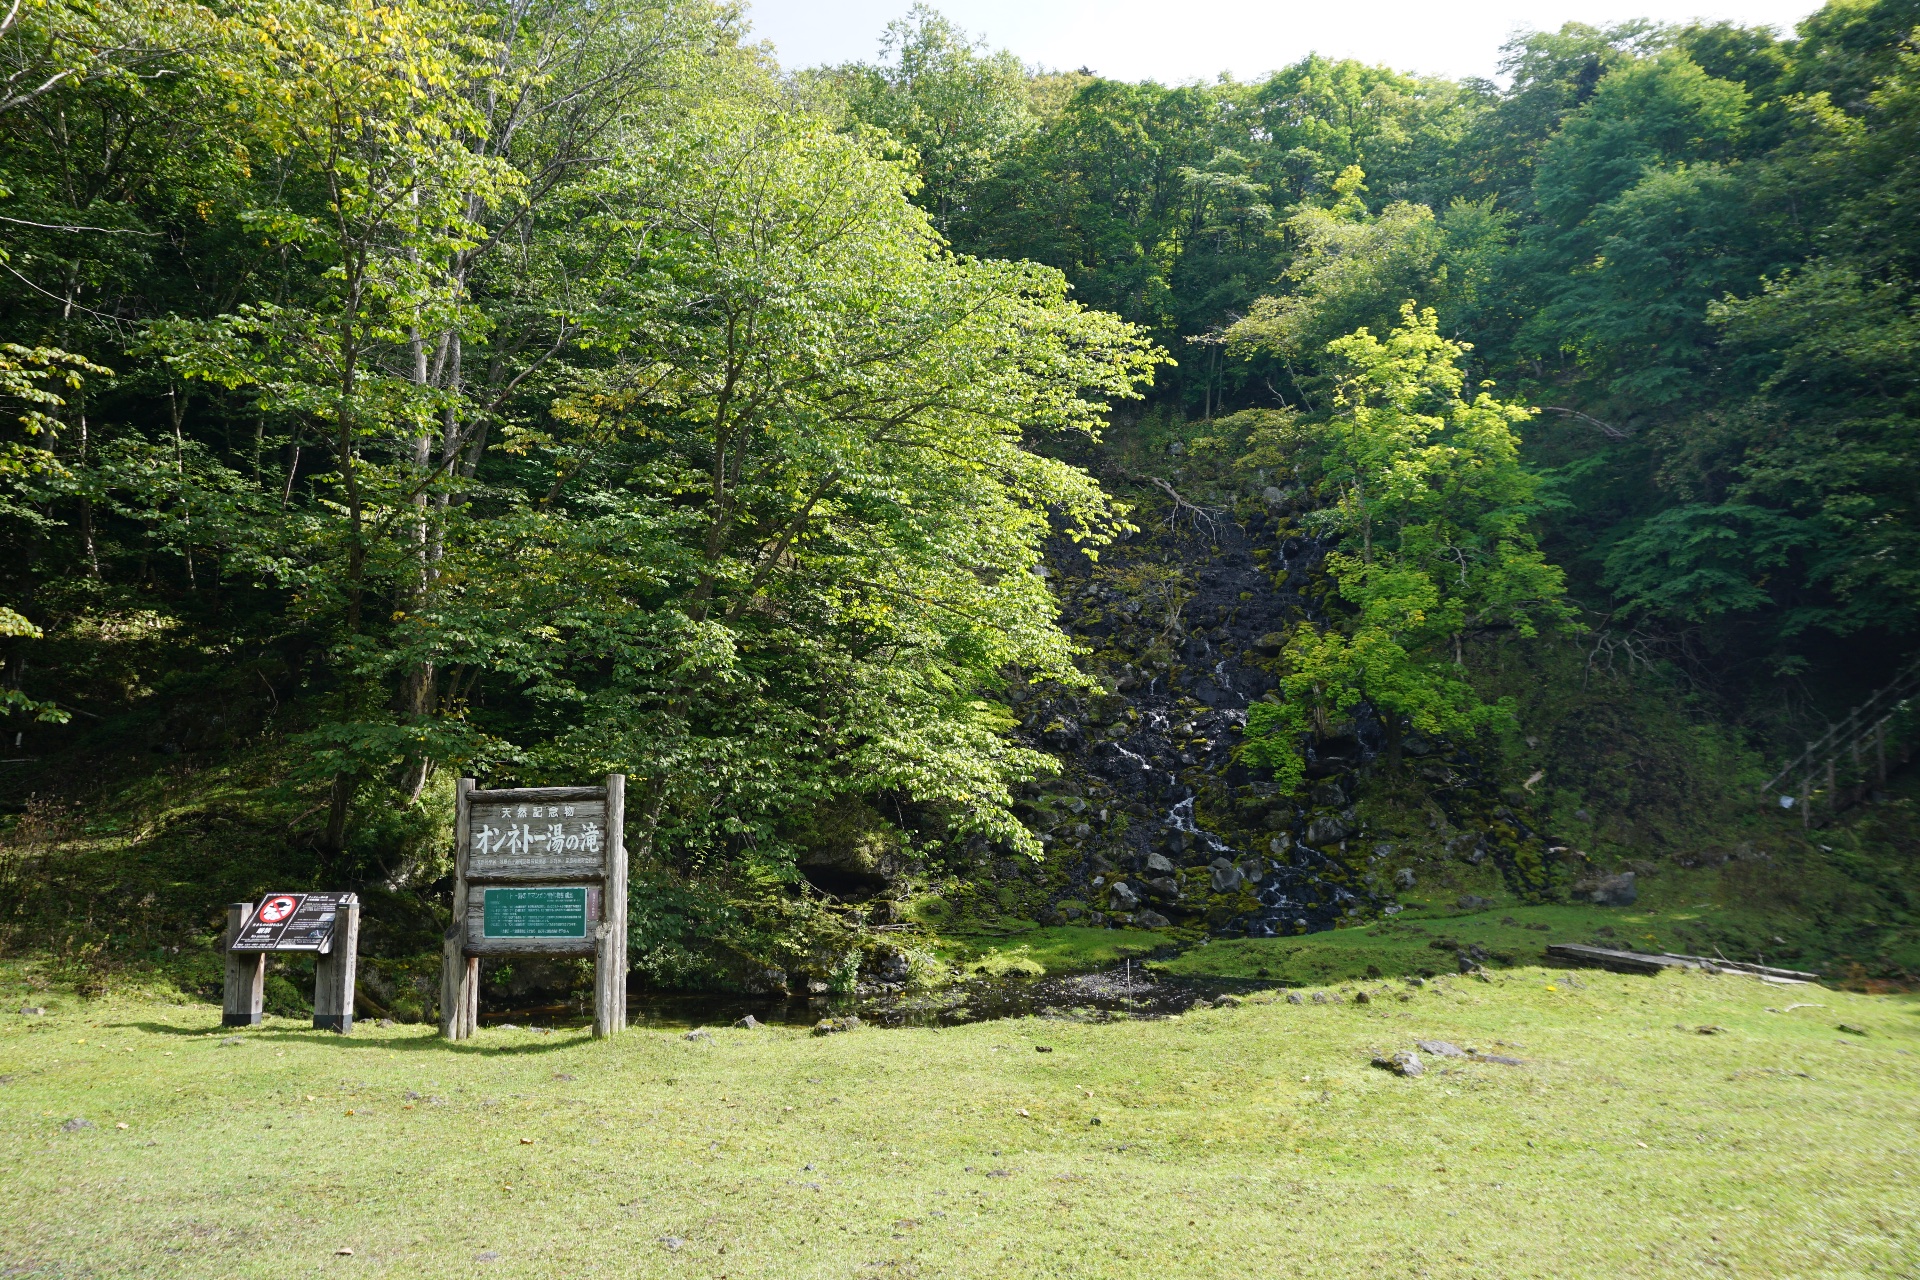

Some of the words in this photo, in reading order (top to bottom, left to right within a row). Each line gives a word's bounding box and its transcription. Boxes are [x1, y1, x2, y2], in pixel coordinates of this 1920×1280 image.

[501, 806, 575, 819] 天然記念物
[475, 822, 600, 855] オンネトー湯の滝
